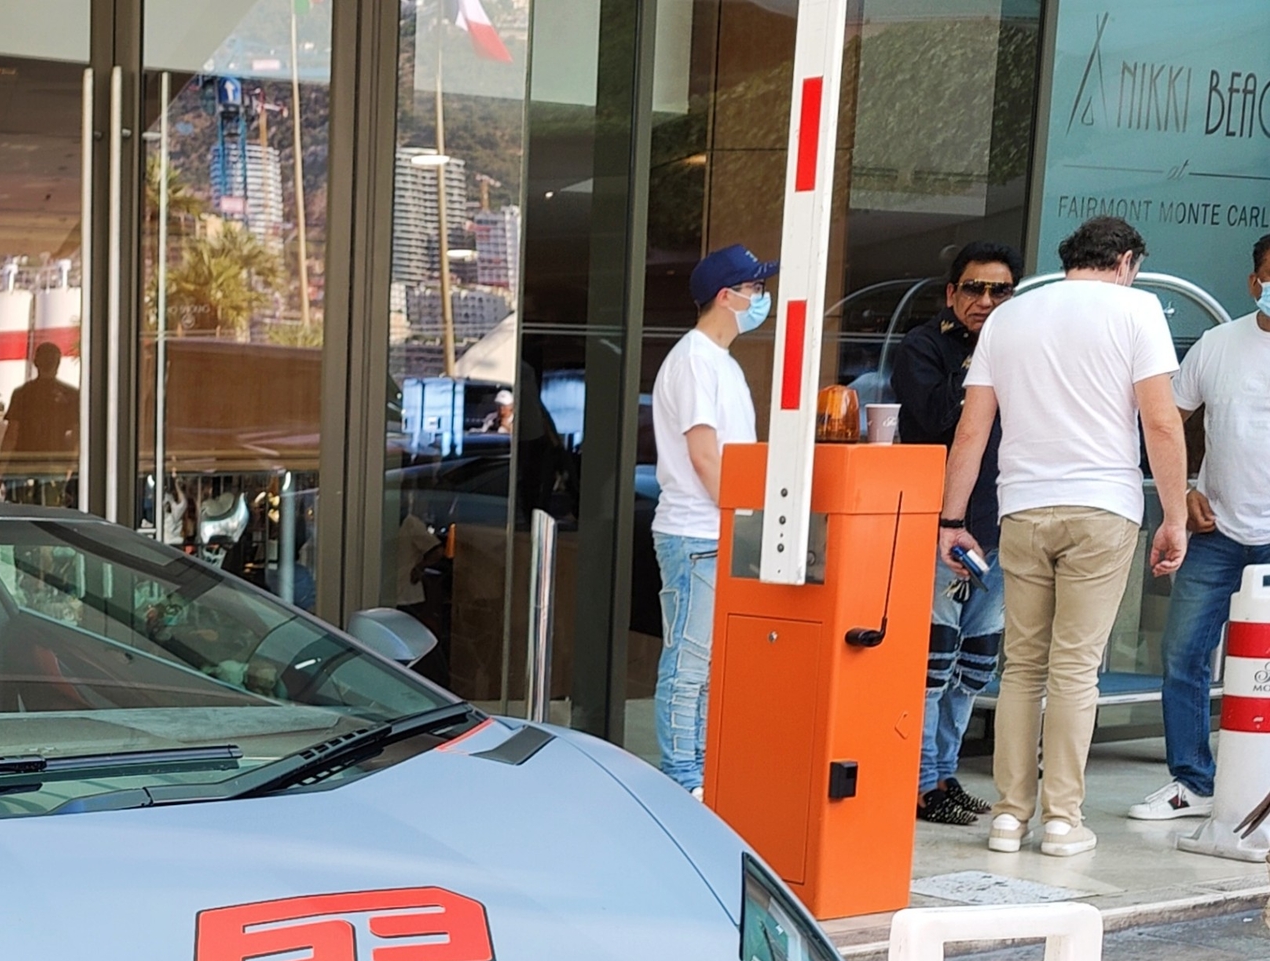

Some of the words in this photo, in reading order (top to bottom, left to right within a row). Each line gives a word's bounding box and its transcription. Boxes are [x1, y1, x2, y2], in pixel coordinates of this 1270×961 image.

[1117, 60, 1192, 133] NIKKI
[1166, 159, 1190, 181] at
[1058, 195, 1153, 222] FAIRMONT
[1159, 200, 1221, 226] MONTE
[1227, 204, 1270, 228] CARL
